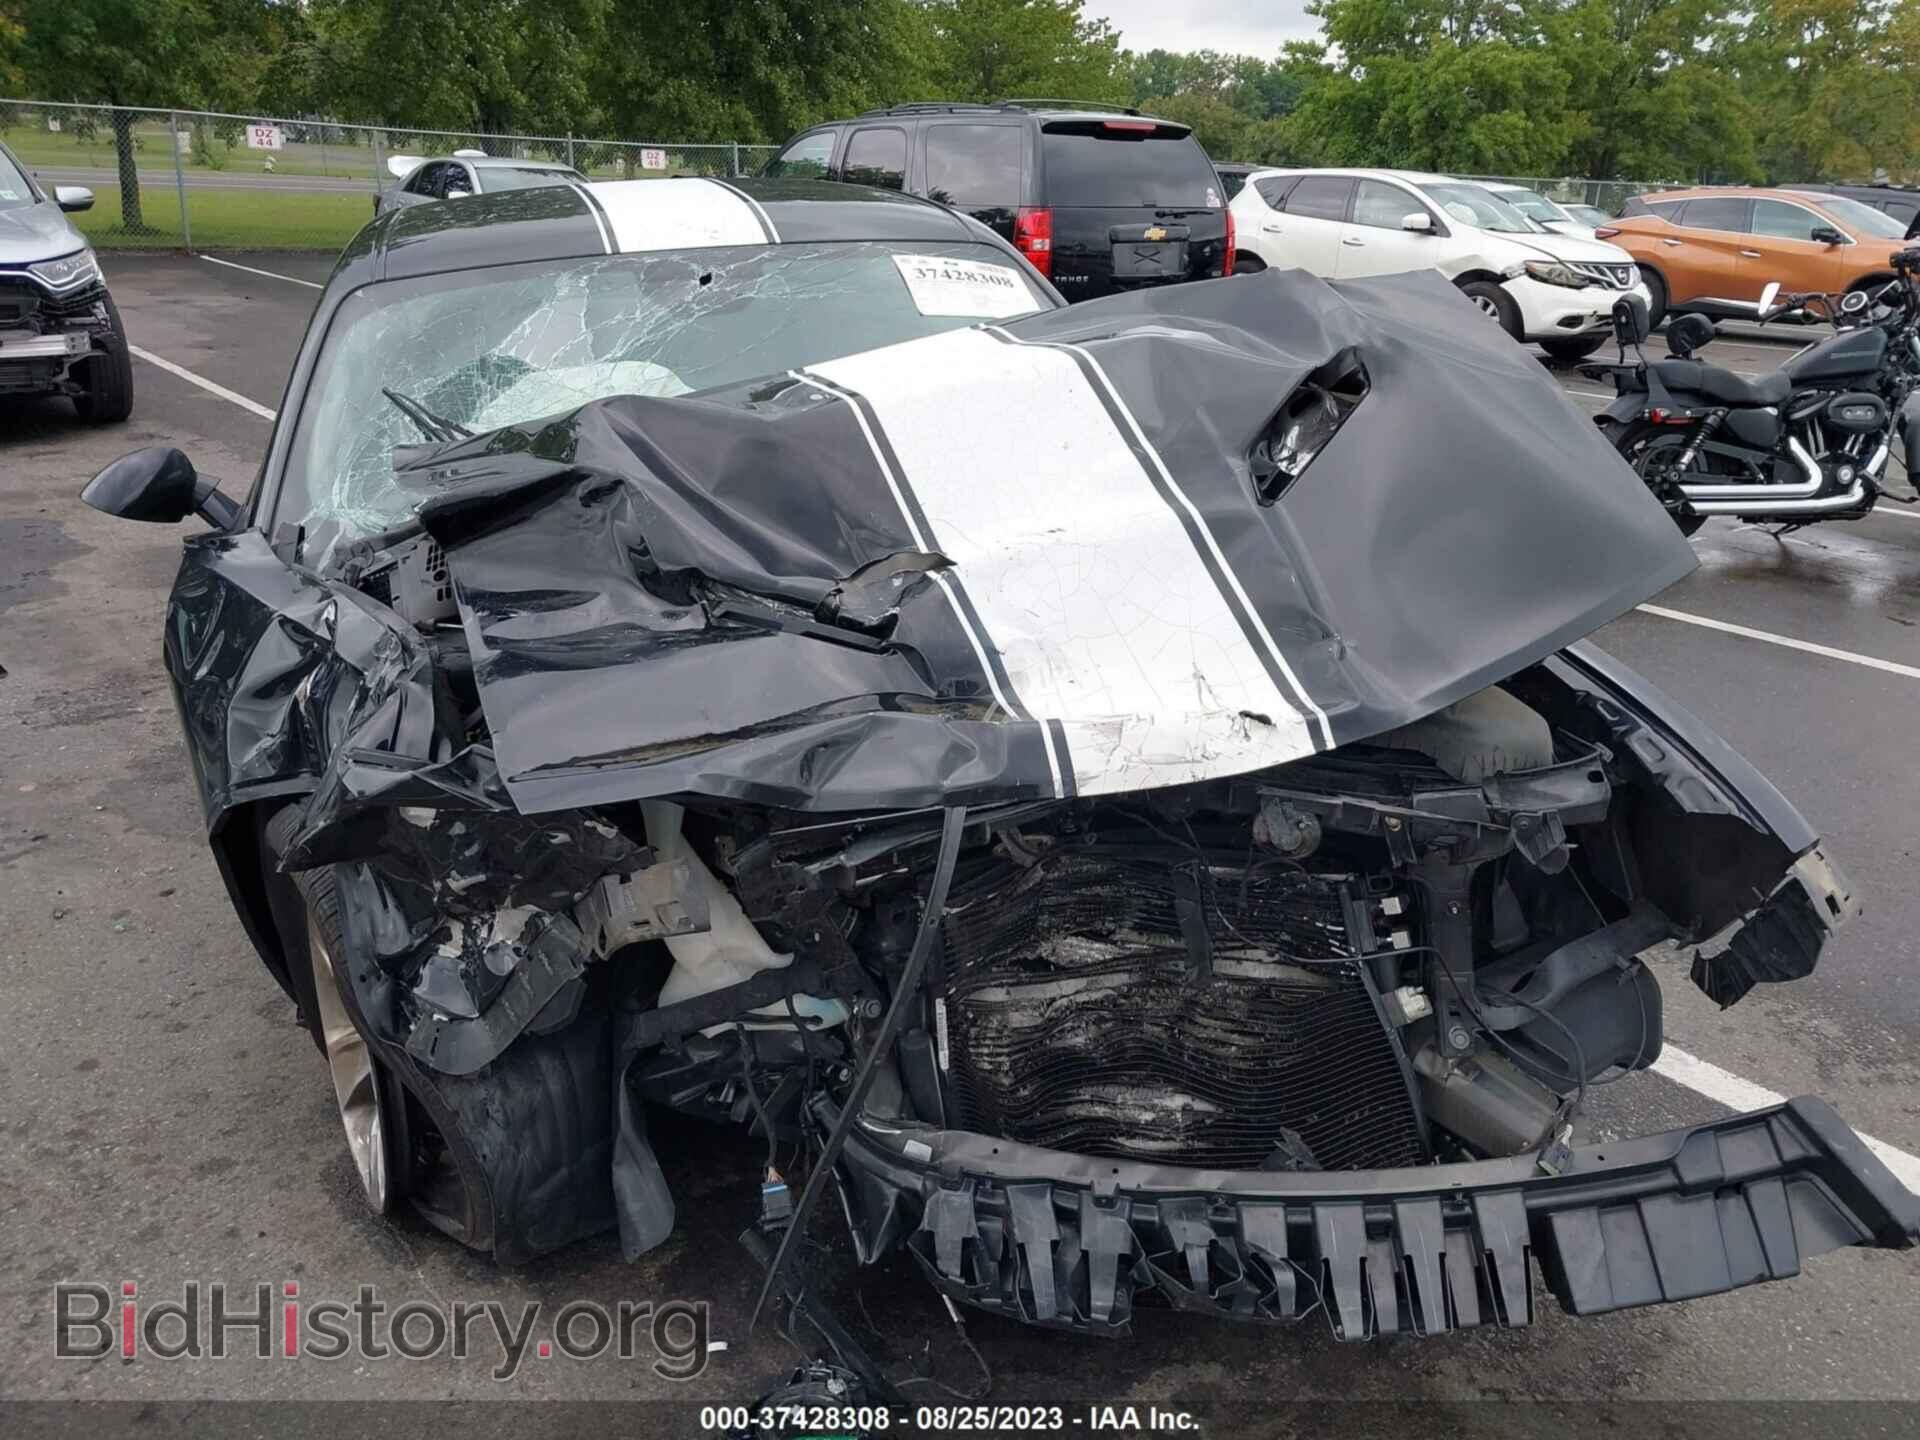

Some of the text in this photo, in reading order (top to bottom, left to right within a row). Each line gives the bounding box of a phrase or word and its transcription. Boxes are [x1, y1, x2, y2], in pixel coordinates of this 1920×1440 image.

[255, 128, 273, 138] DZ
[256, 138, 273, 146] 44
[913, 266, 1015, 288] 37428308
[1055, 275, 1089, 283] TAHOE
